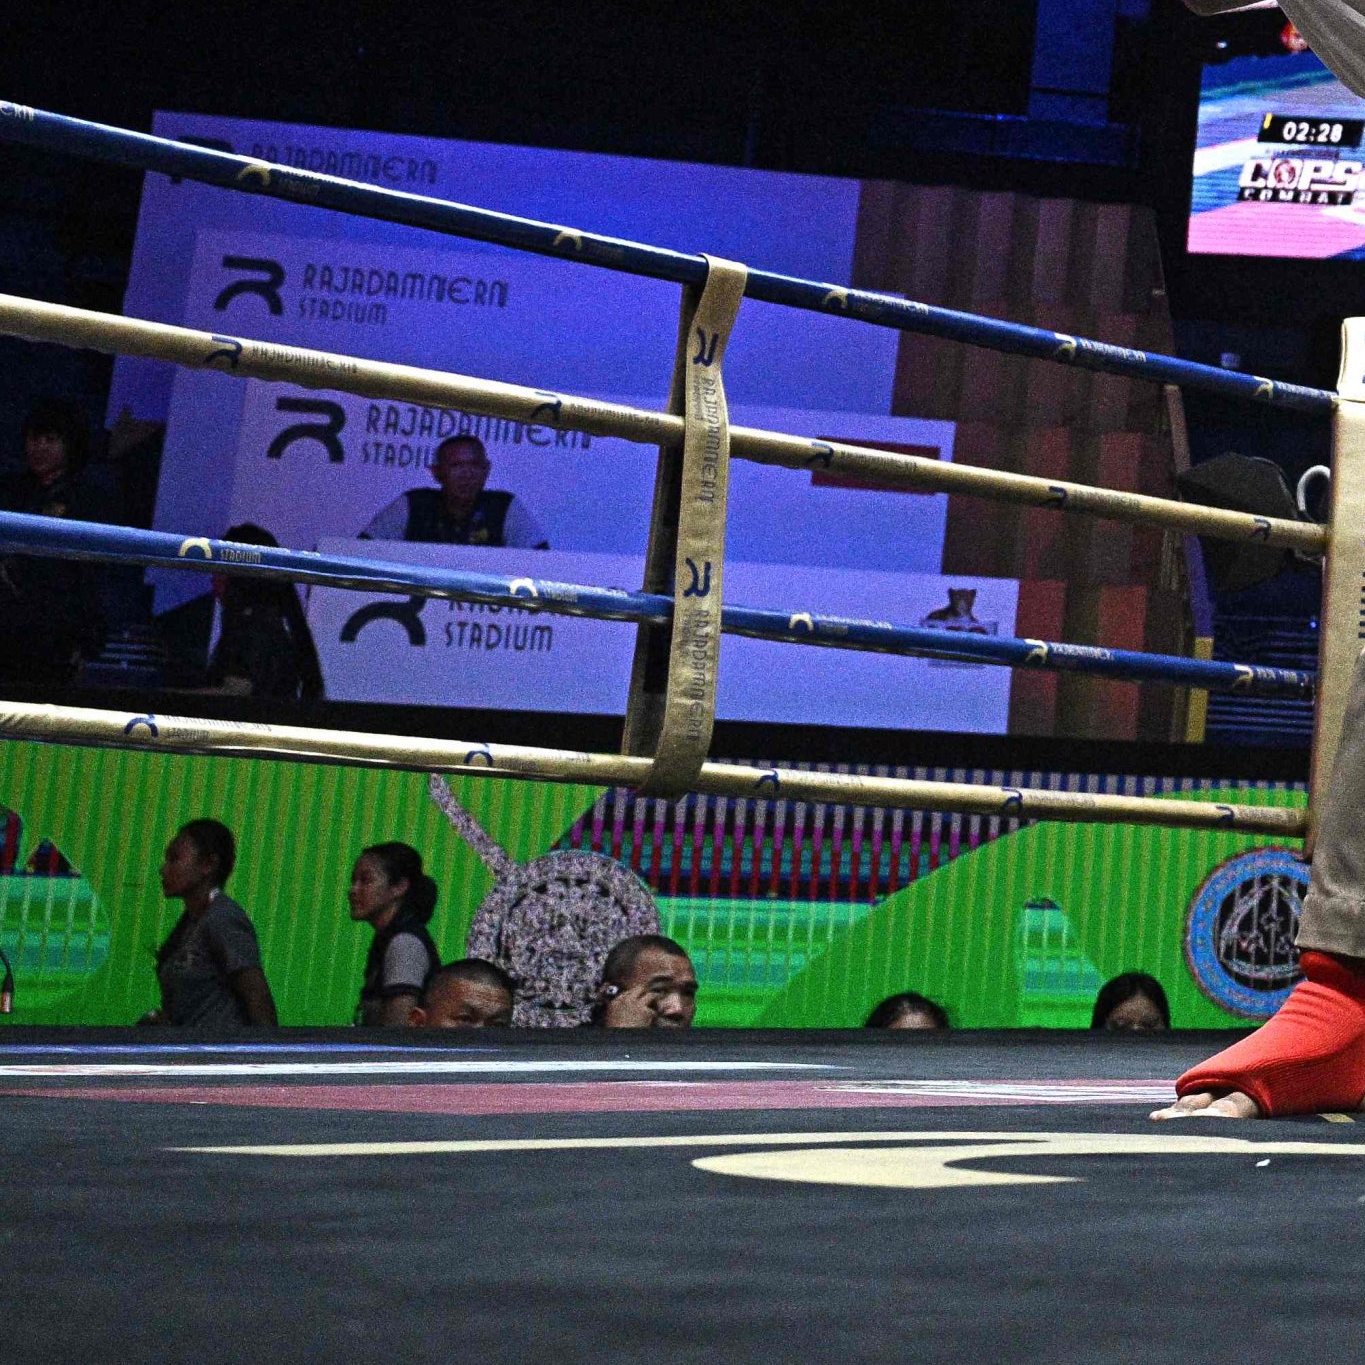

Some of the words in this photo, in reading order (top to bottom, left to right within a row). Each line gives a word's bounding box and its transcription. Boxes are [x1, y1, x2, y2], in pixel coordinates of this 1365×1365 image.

[1282, 121, 1344, 143] 02:28
[1238, 158, 1364, 193] COPS
[303, 263, 509, 308] RAJADAMNERN
[298, 298, 387, 325] STADIUM
[362, 442, 437, 466] STADIU
[445, 623, 553, 653] STADIUM
